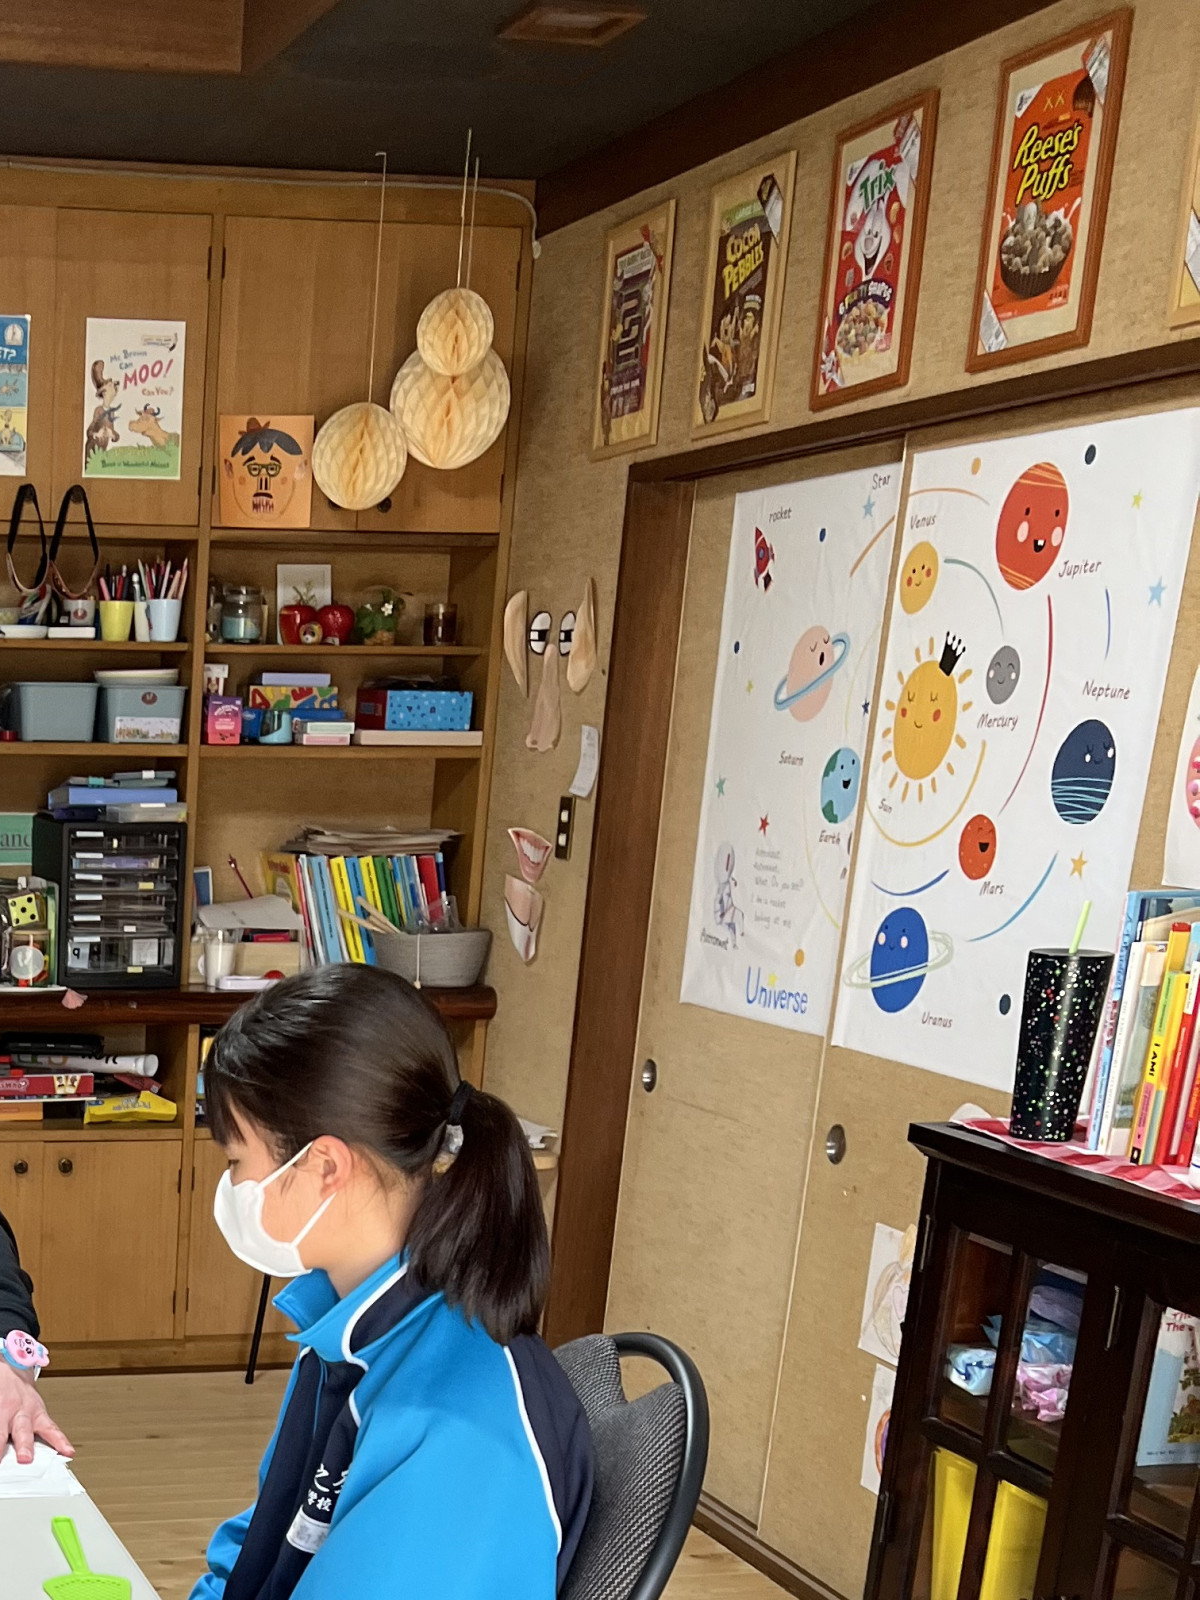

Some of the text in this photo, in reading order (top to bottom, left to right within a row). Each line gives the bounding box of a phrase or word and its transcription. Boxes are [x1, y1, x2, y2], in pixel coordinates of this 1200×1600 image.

[1013, 122, 1083, 171] Reese's
[859, 160, 897, 214] Trix
[1015, 153, 1073, 205] Puffs
[726, 223, 761, 264] COCOA
[723, 242, 764, 300] PEBBLES
[123, 358, 174, 391] MOO!
[872, 472, 891, 490] Star
[769, 506, 792, 524] rocket
[910, 514, 937, 531] Venus
[1058, 559, 1102, 580] Jupiter
[1082, 680, 1131, 702] Neptune
[976, 712, 1019, 732] Mercury
[779, 750, 804, 767] Saturn
[878, 797, 893, 814] Sun
[818, 829, 841, 846] Earth
[979, 881, 1005, 897] Mars
[746, 964, 809, 1014] Universe
[921, 1011, 954, 1029] Uranus
[1165, 1321, 1186, 1333] The
